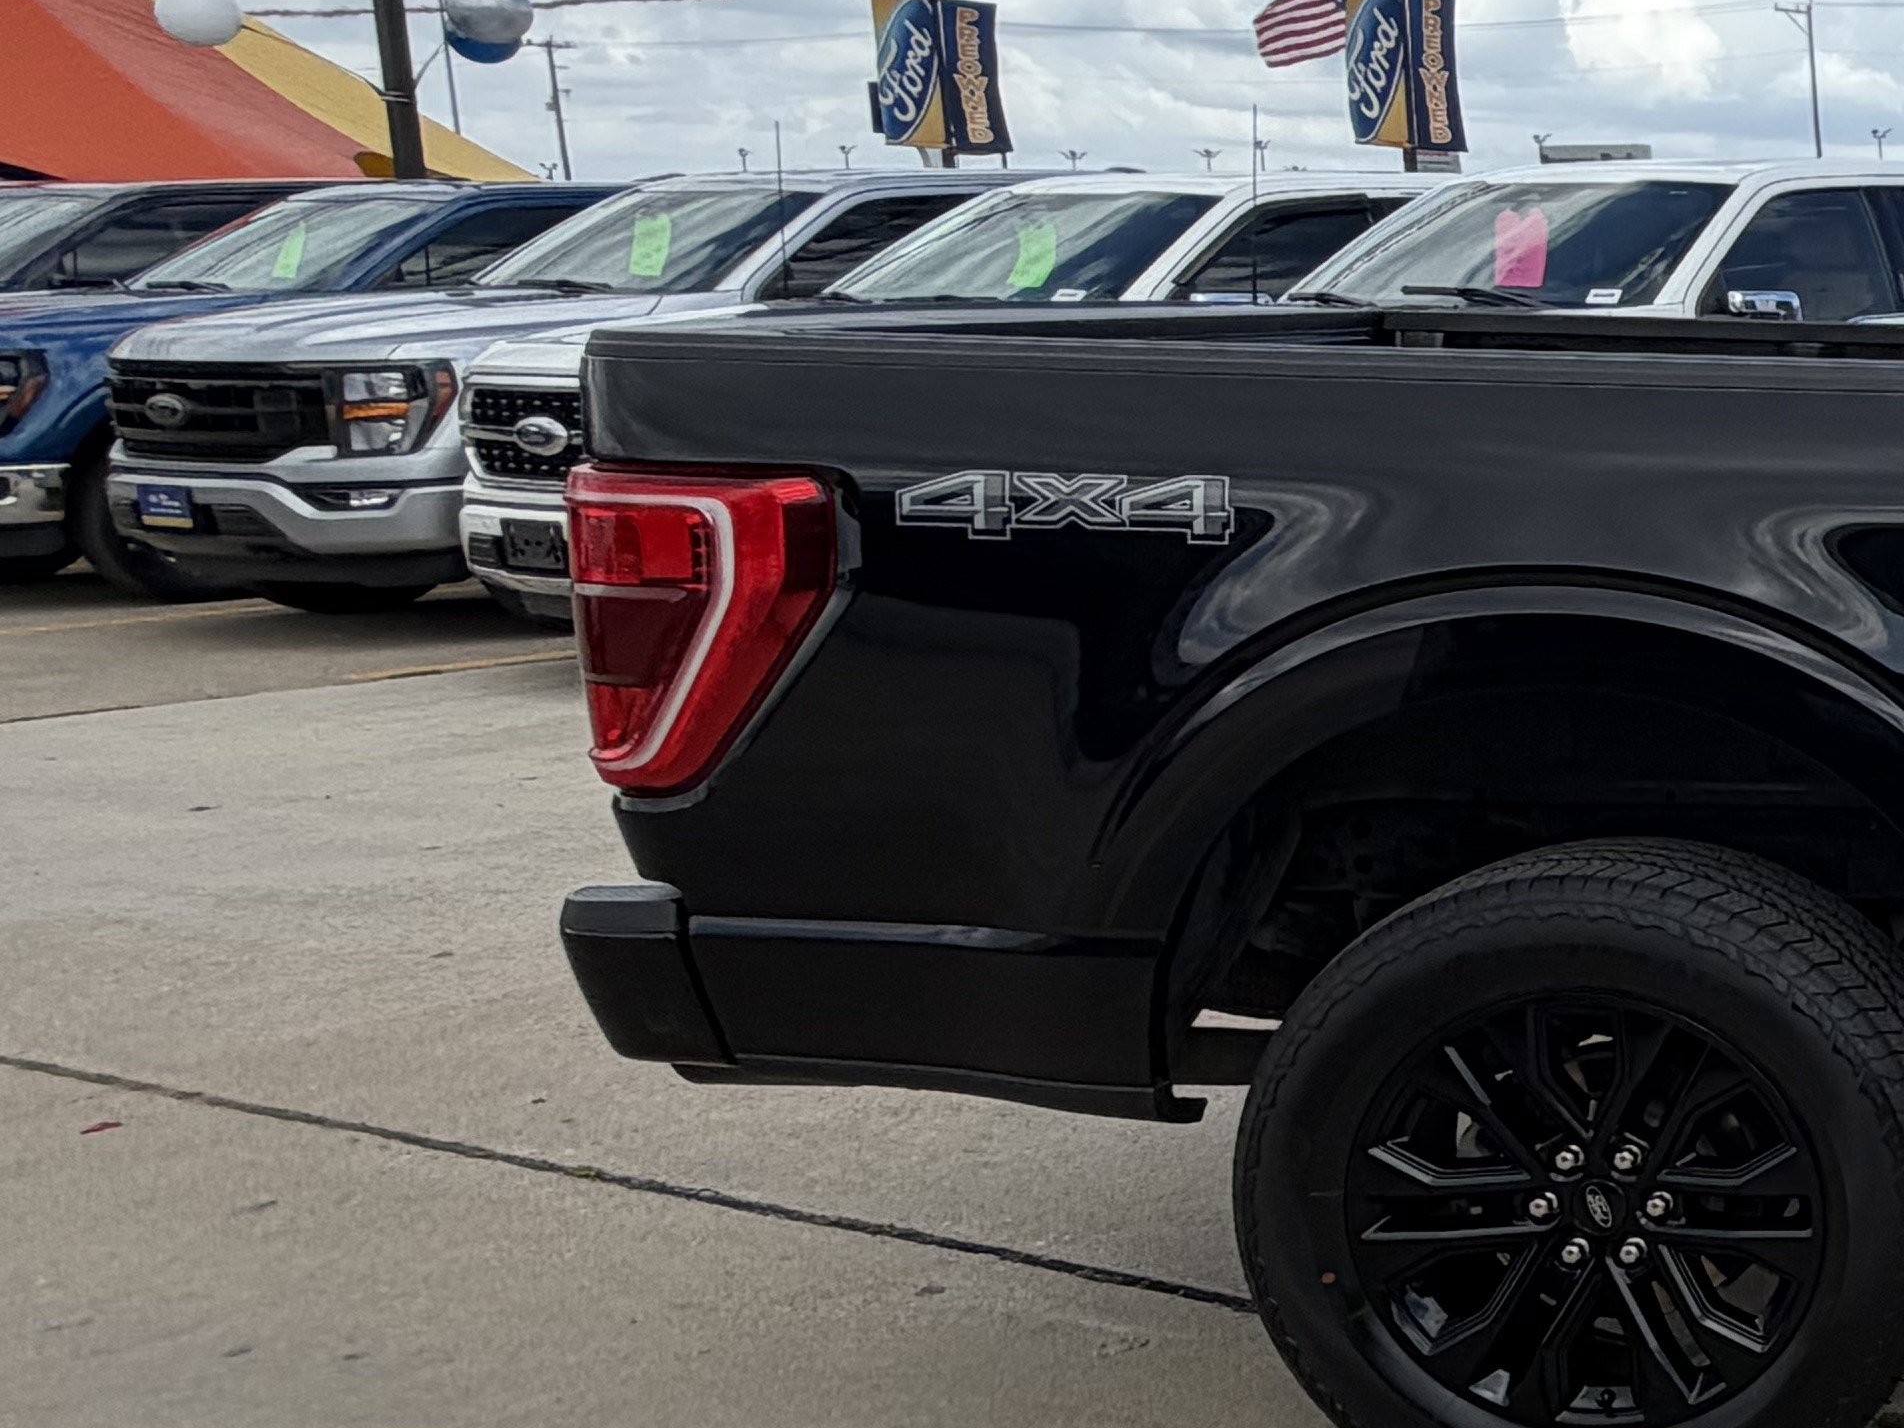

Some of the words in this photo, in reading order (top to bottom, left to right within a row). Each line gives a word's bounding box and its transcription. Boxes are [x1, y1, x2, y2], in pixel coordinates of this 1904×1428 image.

[880, 18, 933, 122] Ford
[953, 6, 994, 143] PREOWNED
[1347, 7, 1399, 119] Ford
